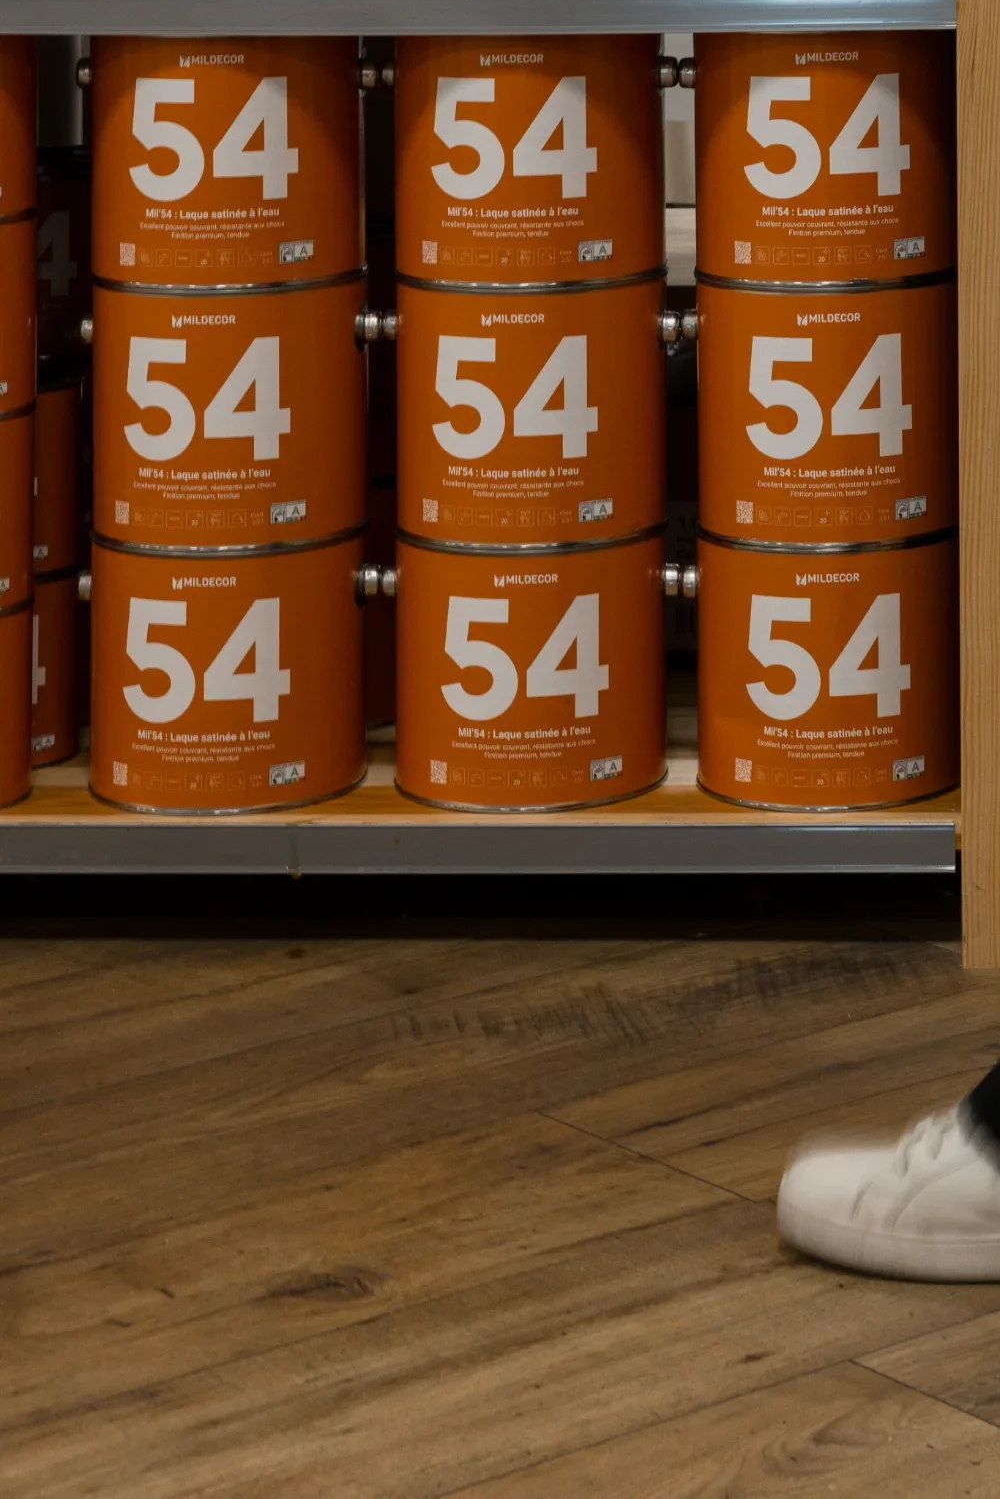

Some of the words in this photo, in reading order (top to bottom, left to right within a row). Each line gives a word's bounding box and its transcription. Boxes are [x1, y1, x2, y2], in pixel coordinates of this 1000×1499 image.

[191, 55, 244, 65] MILDECOR
[491, 54, 544, 64] MILDECOR
[807, 52, 859, 62] MILDECOR
[129, 76, 298, 202] 54
[431, 75, 598, 200] 54
[743, 73, 910, 199] 54
[480, 209, 509, 219] Laque
[511, 208, 547, 217] satinée
[797, 208, 826, 218] Laque
[828, 206, 863, 215] satinée
[183, 315, 236, 325] MILDECOR
[493, 313, 545, 324] MILDECOR
[809, 313, 860, 323] MILDECOR
[124, 335, 291, 461] 54
[432, 334, 598, 460] 54
[745, 333, 913, 461] 54
[481, 469, 510, 479] Laque
[511, 468, 547, 477] satinée
[798, 469, 828, 479] Laque
[830, 467, 865, 477] satinée
[183, 577, 237, 588] MILDECOR
[506, 574, 558, 585] MILDECOR
[808, 573, 860, 583] MILDECOR
[122, 597, 290, 724] 54
[440, 593, 609, 721] 54
[746, 593, 911, 721] 54
[493, 730, 522, 740] Laque
[524, 729, 559, 738] satinée
[796, 729, 825, 740] Laque
[827, 728, 862, 738] satinée
